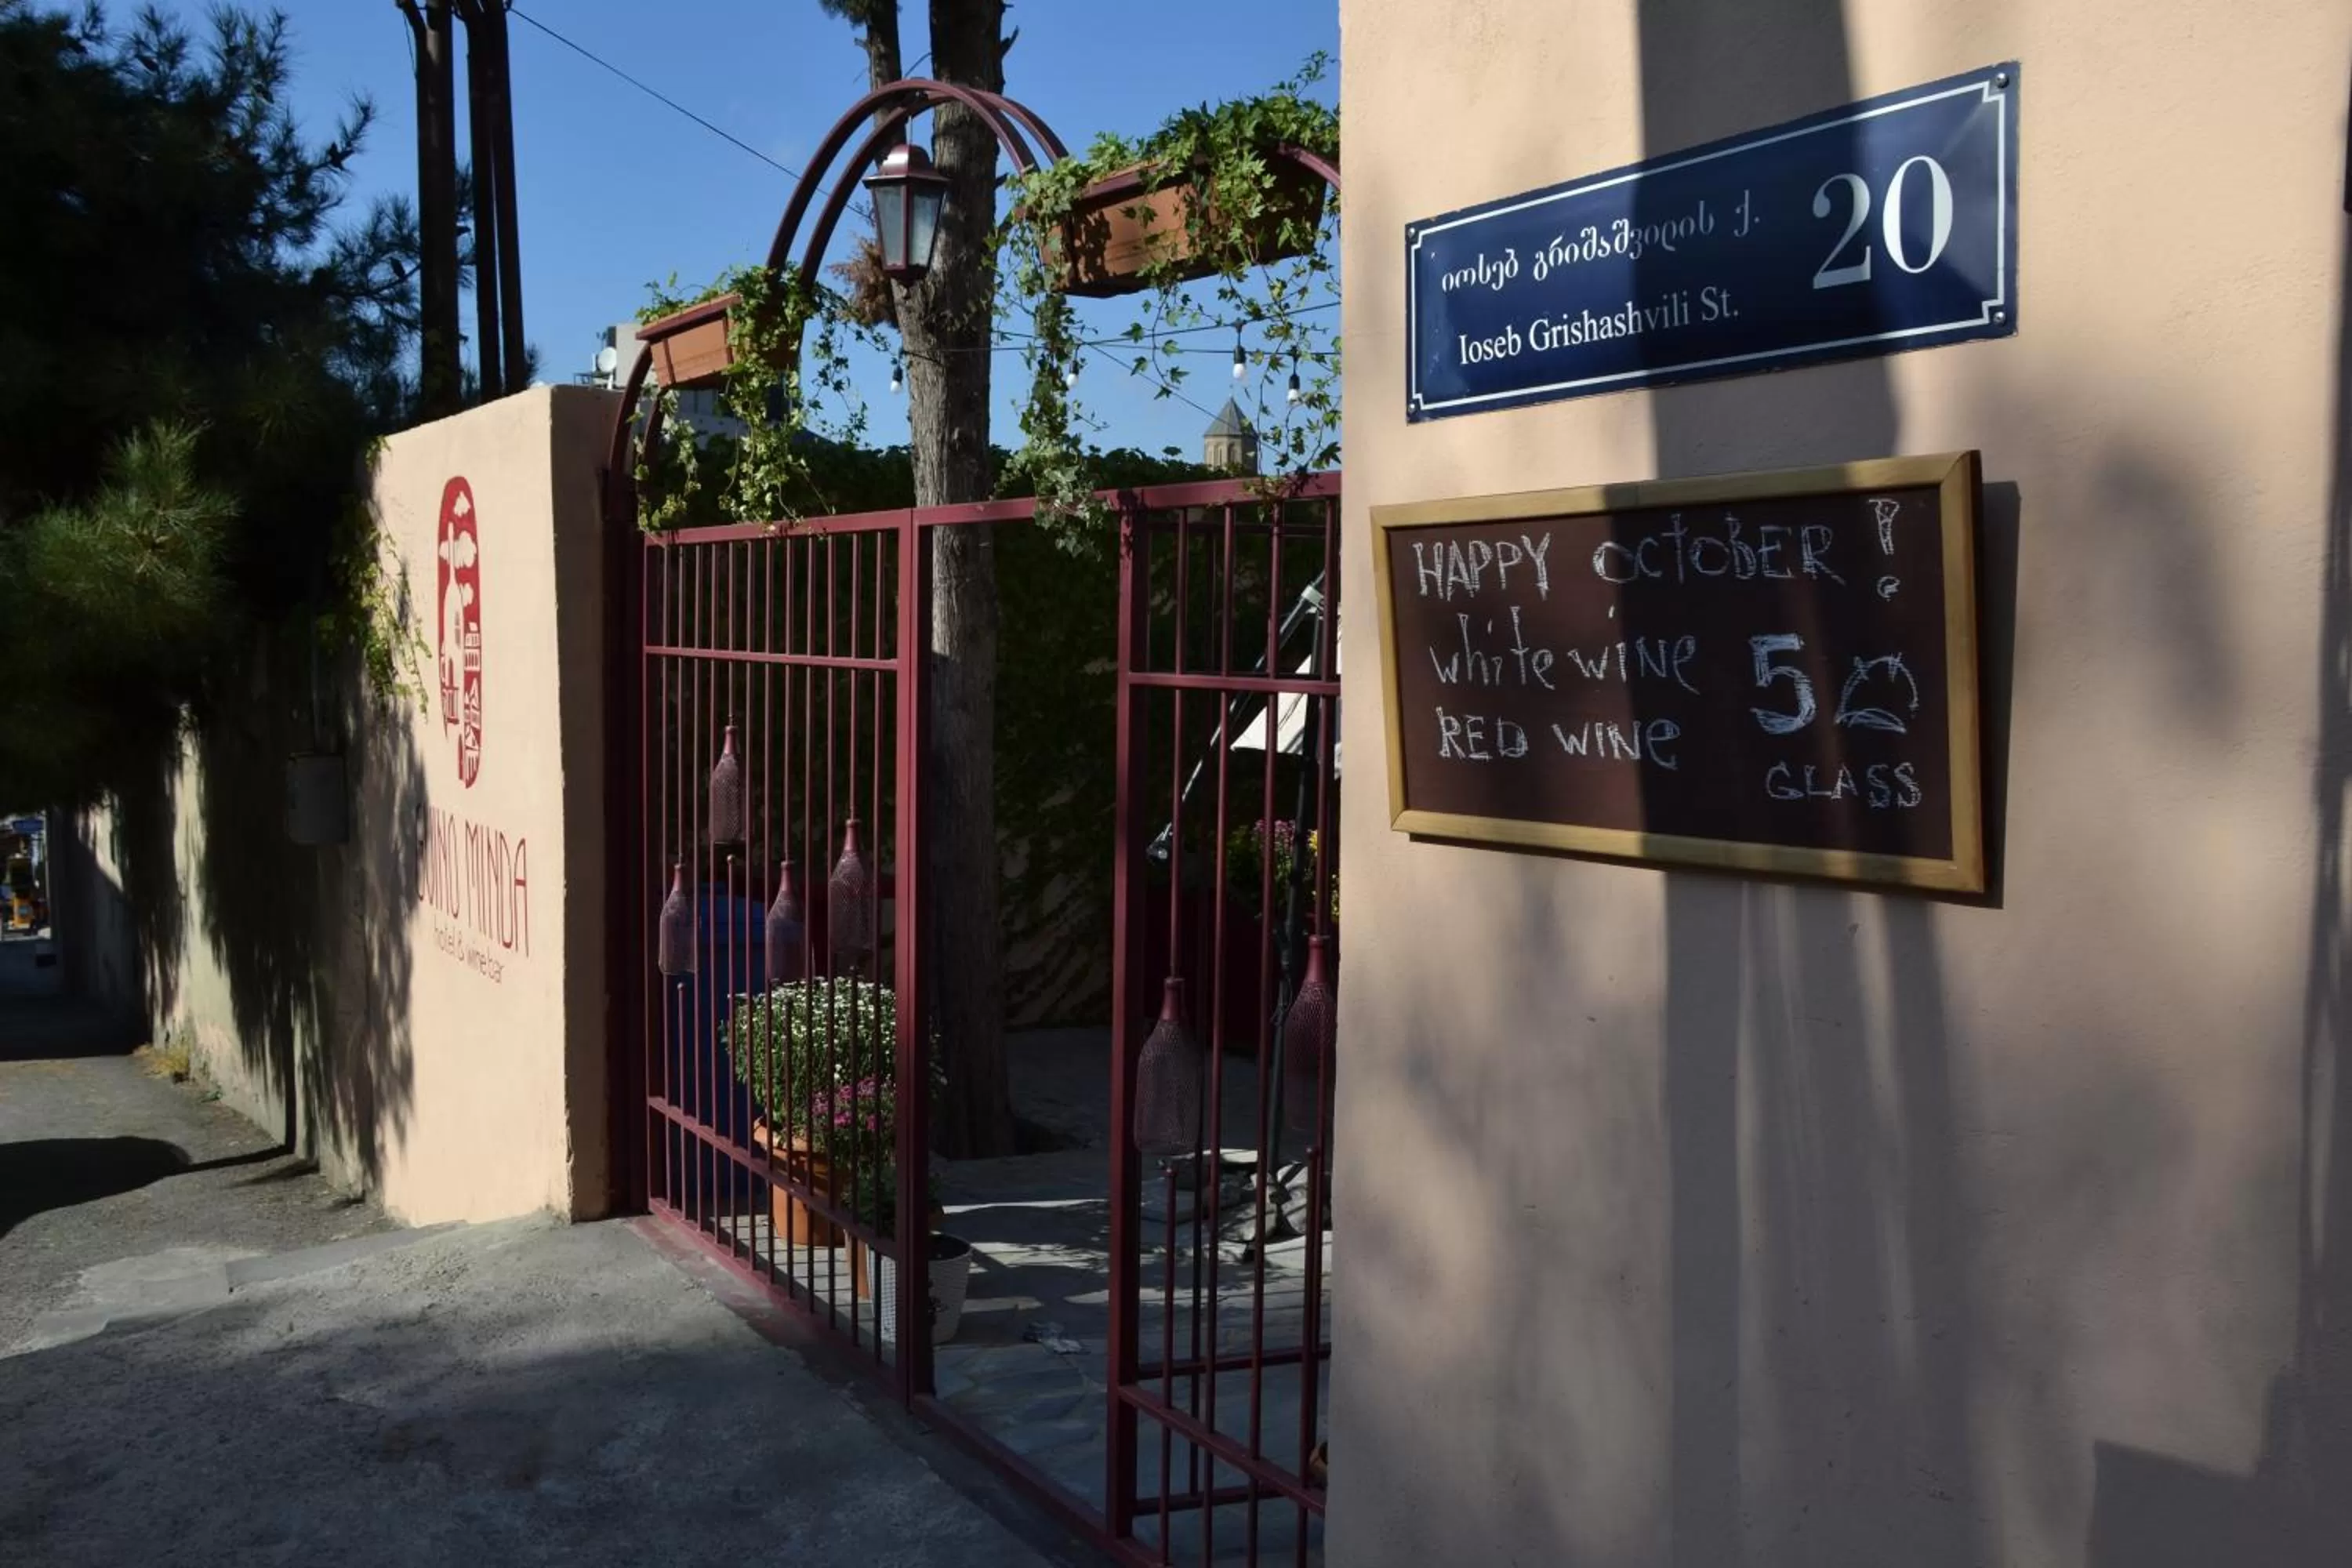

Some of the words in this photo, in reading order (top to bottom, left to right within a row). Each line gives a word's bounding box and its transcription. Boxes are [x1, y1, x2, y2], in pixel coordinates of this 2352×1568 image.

[1441, 248, 1519, 292] იოსებ
[1532, 200, 1715, 282] გრიშაშვილის
[1812, 154, 1954, 289] 20
[1458, 325, 1522, 365] Ioseb
[1529, 289, 1690, 352] Grishashvili
[1700, 285, 1740, 321] St.
[1412, 532, 1552, 601] HAPPY
[1436, 706, 1529, 760] RED
[1766, 760, 1922, 809] GLASS
[465, 818, 529, 958] MINDA
